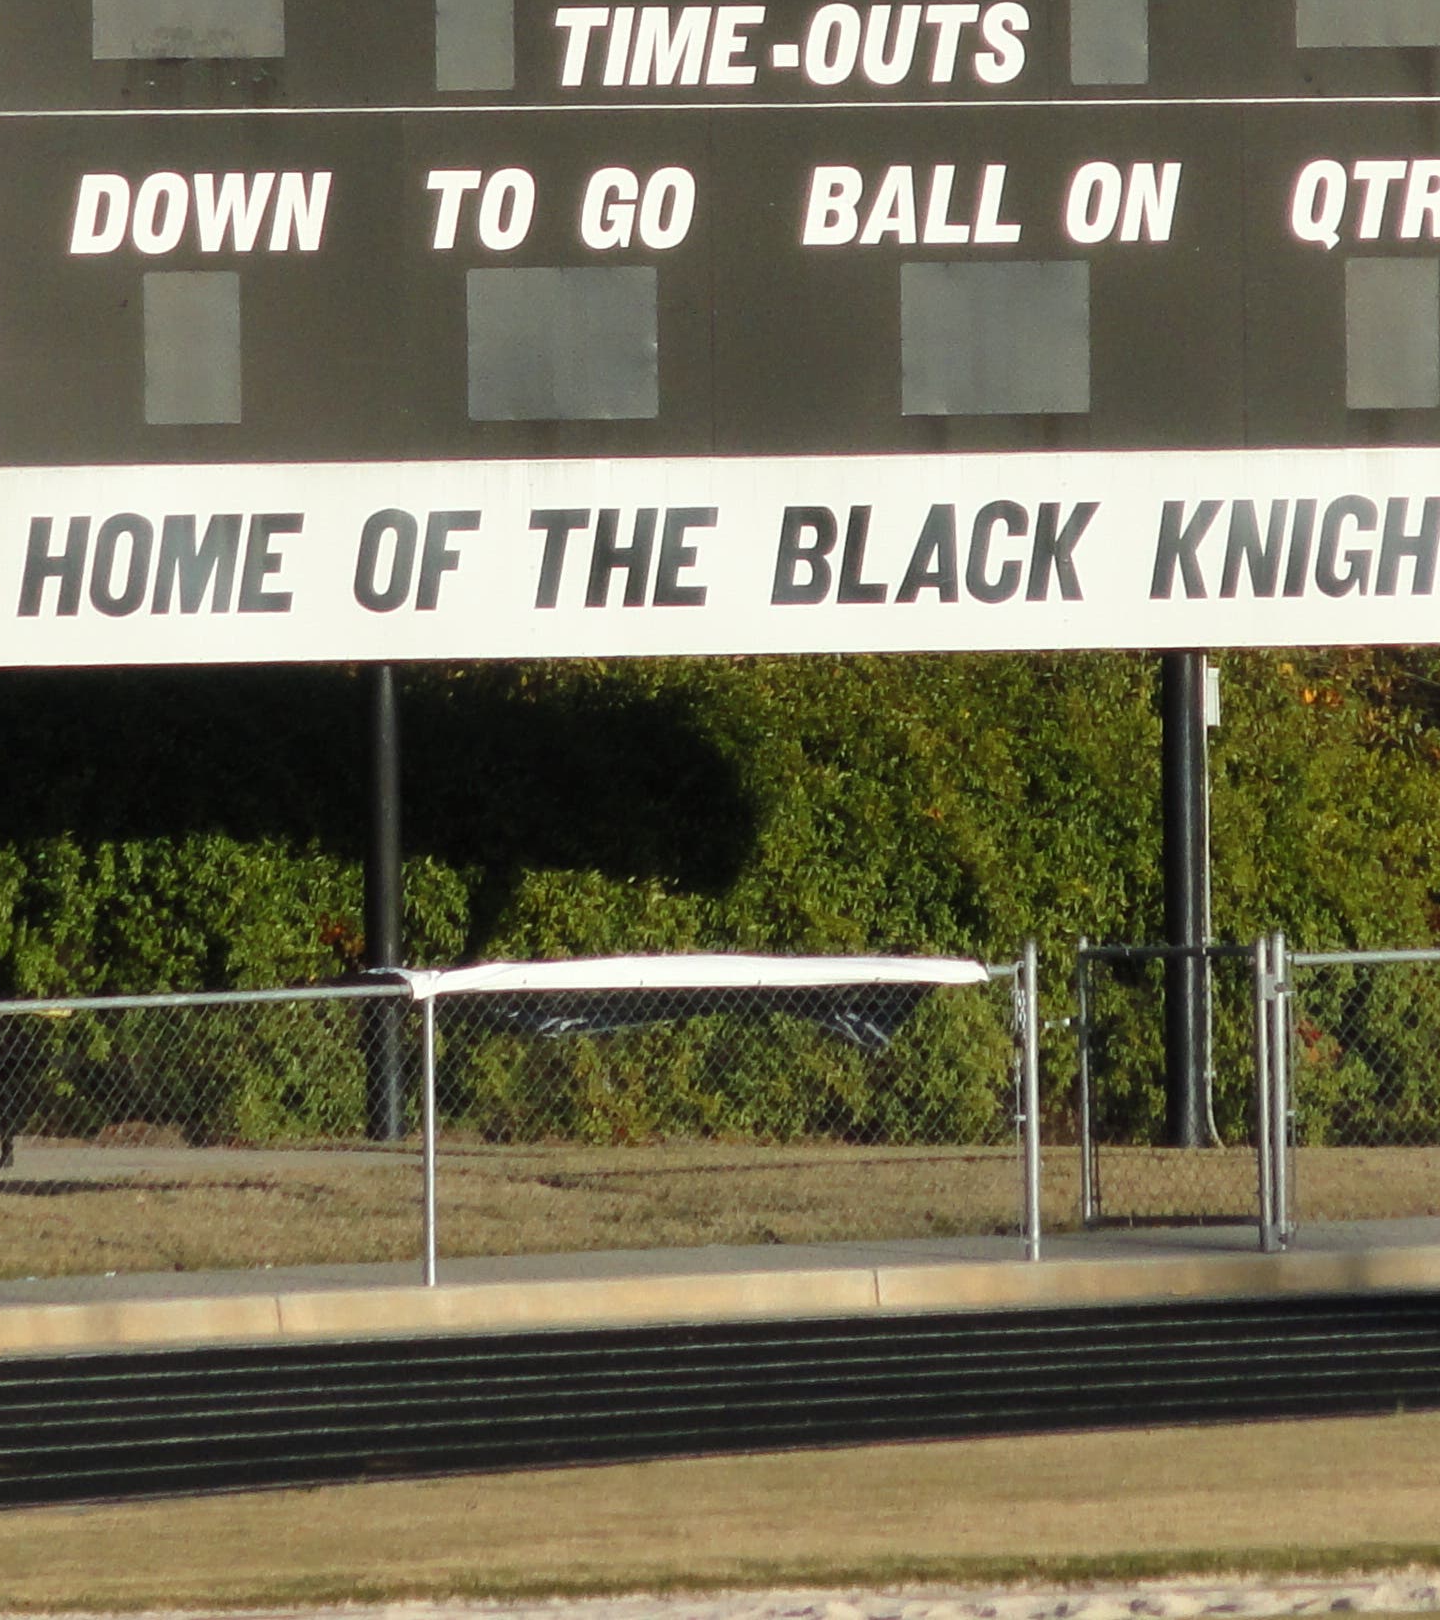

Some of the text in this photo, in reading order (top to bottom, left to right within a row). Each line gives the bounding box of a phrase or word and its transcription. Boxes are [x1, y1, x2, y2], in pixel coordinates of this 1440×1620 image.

[553, 1, 1031, 87] TIME-OUTS
[68, 171, 333, 255] DOWN
[425, 166, 697, 251] TO GO
[802, 161, 1183, 246] BALL ON
[17, 512, 305, 617] HOME
[353, 508, 482, 613] OF
[528, 507, 719, 609] THE
[770, 499, 1101, 606] BLACK
